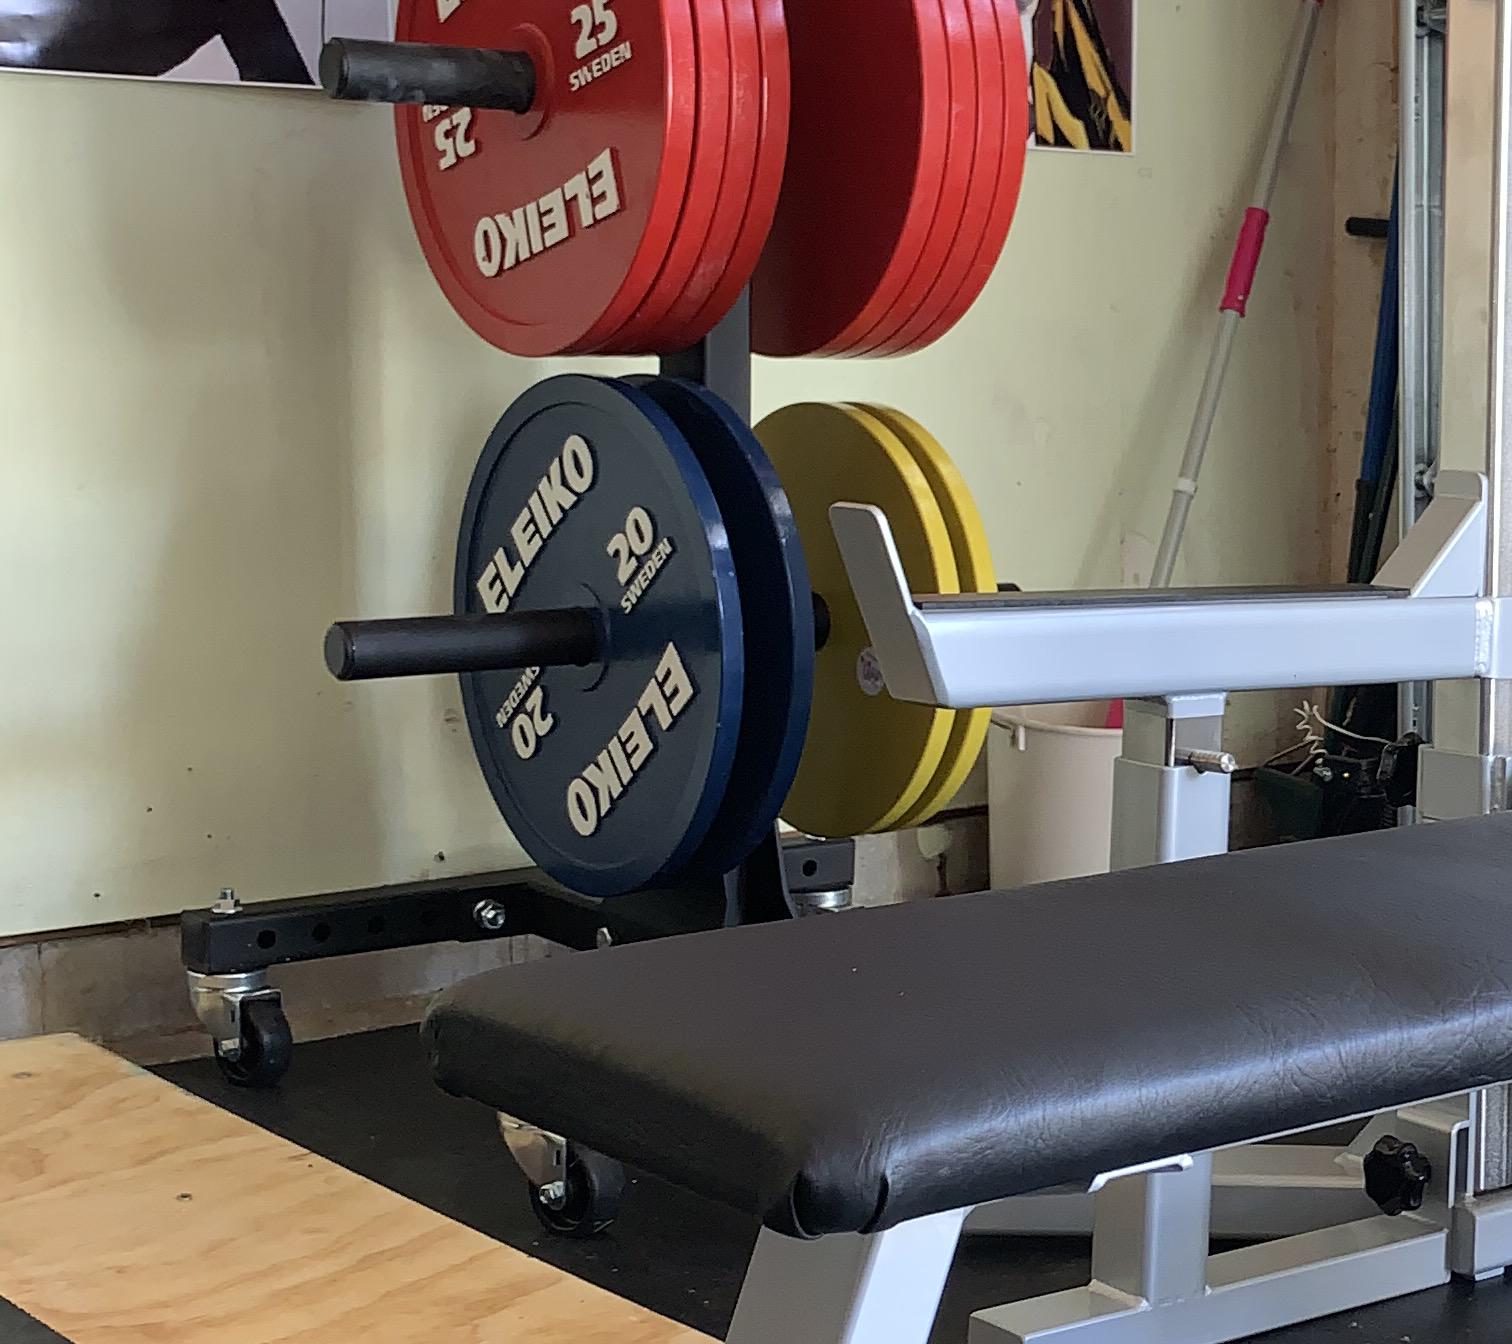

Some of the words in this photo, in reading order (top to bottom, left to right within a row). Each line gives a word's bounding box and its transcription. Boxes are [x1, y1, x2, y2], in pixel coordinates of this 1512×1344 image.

[568, 41, 632, 91] SWEDEN
[434, 107, 476, 171] 25
[474, 147, 621, 278] ELEIKO
[476, 434, 594, 614] ELEIKO
[606, 506, 654, 587] 20
[620, 537, 673, 614] SWEDEN
[512, 685, 554, 760] 20
[567, 641, 694, 837] ELEIKO
